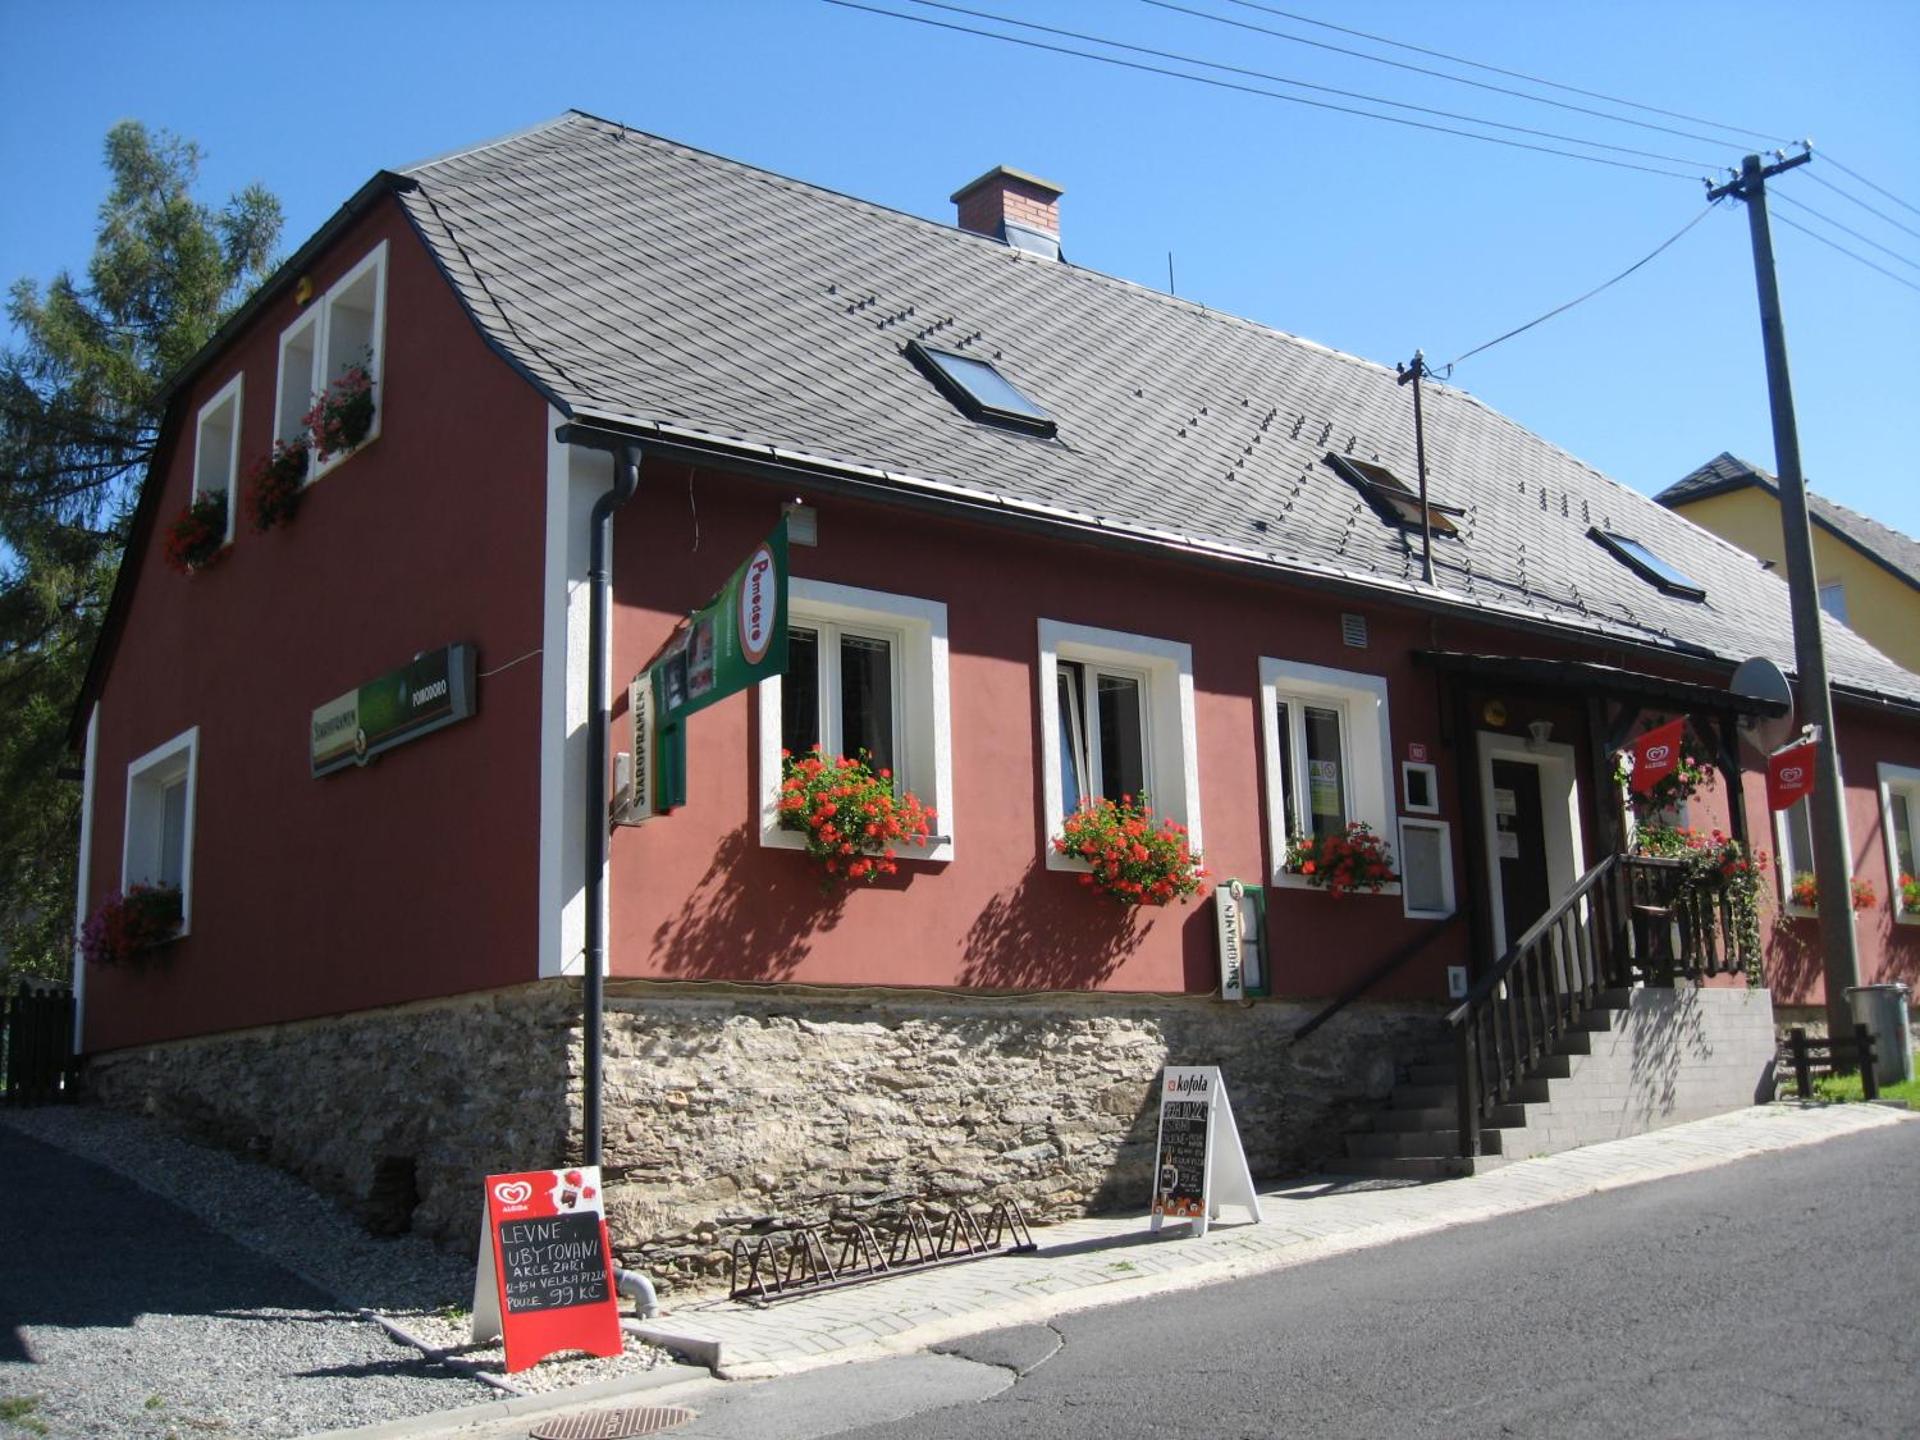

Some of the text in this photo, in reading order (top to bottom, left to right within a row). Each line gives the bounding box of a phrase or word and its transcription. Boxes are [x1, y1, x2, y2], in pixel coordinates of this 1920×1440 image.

[751, 558, 769, 643] Pomodoro
[412, 678, 447, 707] POMODORO
[634, 687, 646, 809] STAROPRAMEN
[1224, 904, 1240, 989] STAROPRAMEN
[1176, 1075, 1208, 1097] kofola
[513, 1264, 550, 1277] AKCE
[581, 1270, 608, 1282] PIZZA
[550, 1286, 573, 1305] 99
